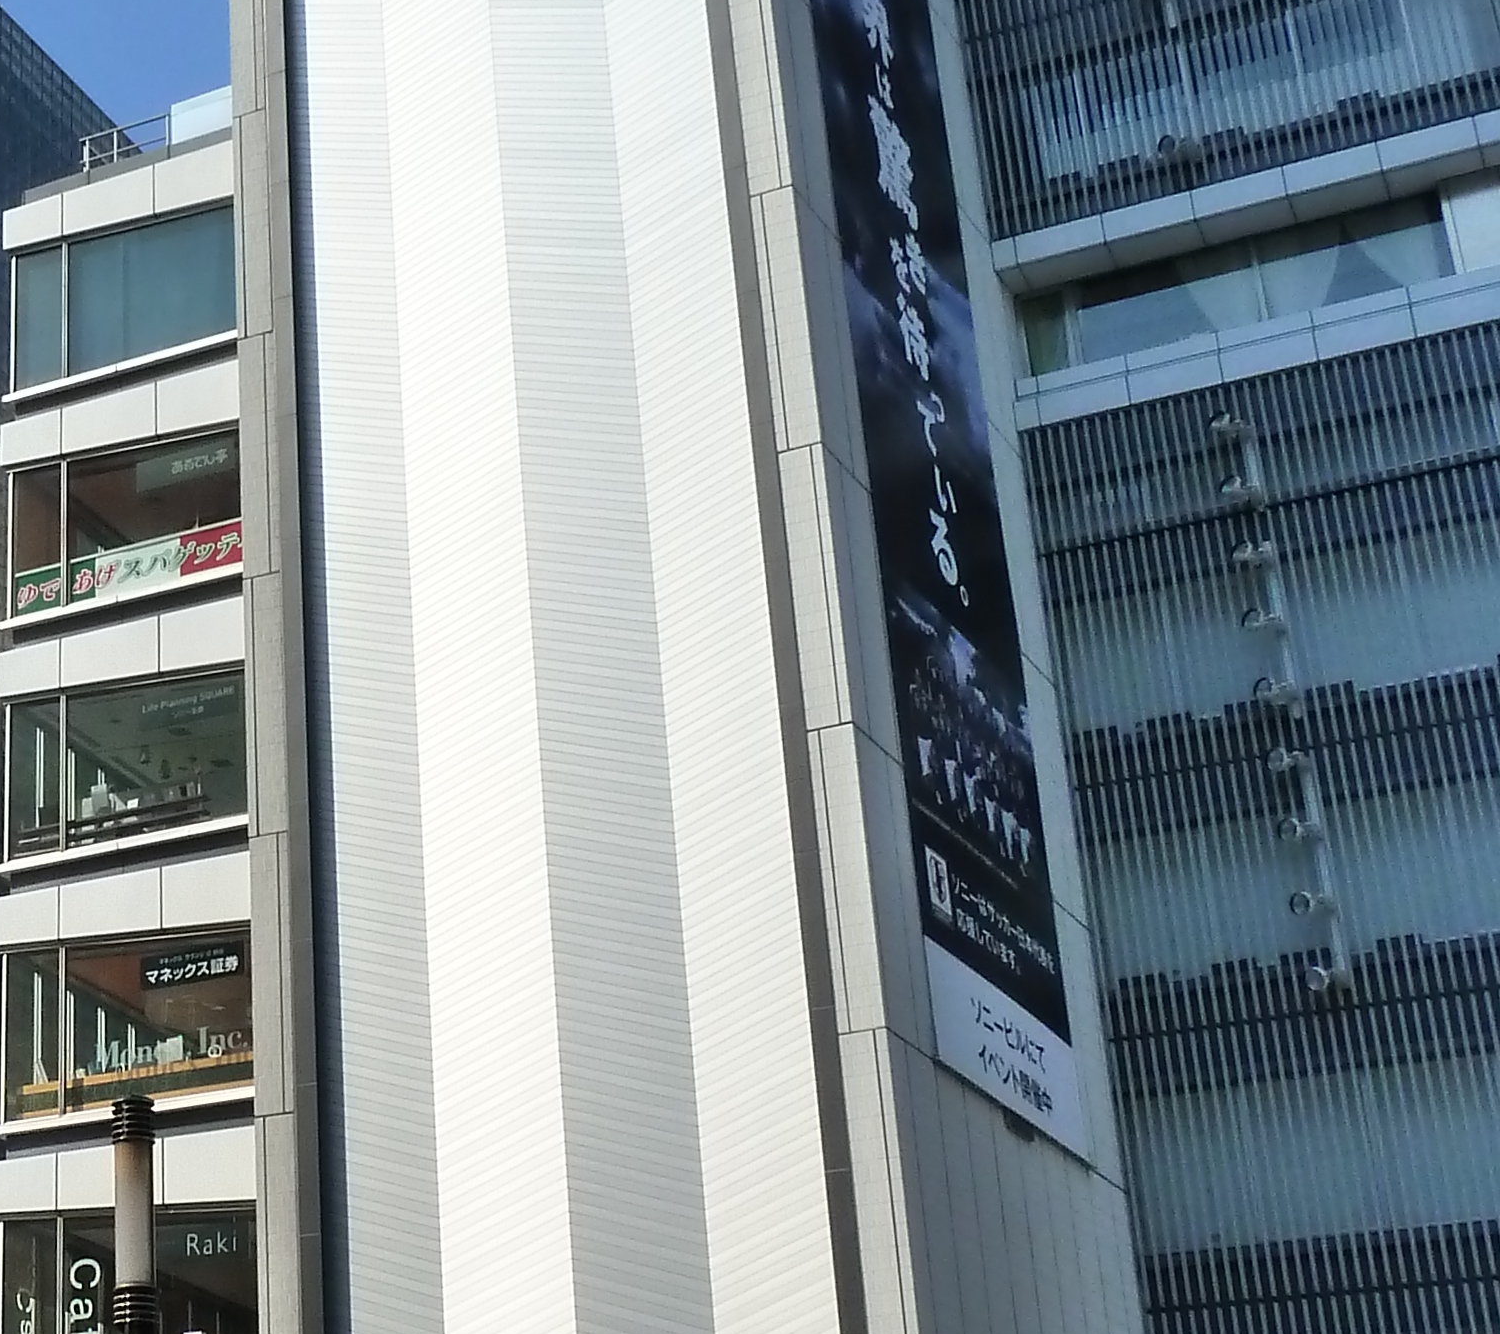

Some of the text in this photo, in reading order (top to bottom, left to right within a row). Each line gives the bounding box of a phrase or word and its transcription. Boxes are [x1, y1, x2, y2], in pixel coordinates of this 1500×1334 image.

[16, 531, 242, 610] ゆであげスパゲッテ
[145, 954, 240, 984] マネックス証券
[197, 1025, 249, 1056] Inc.
[969, 996, 1047, 1074] ソニービルにて
[186, 1231, 238, 1257] Raki
